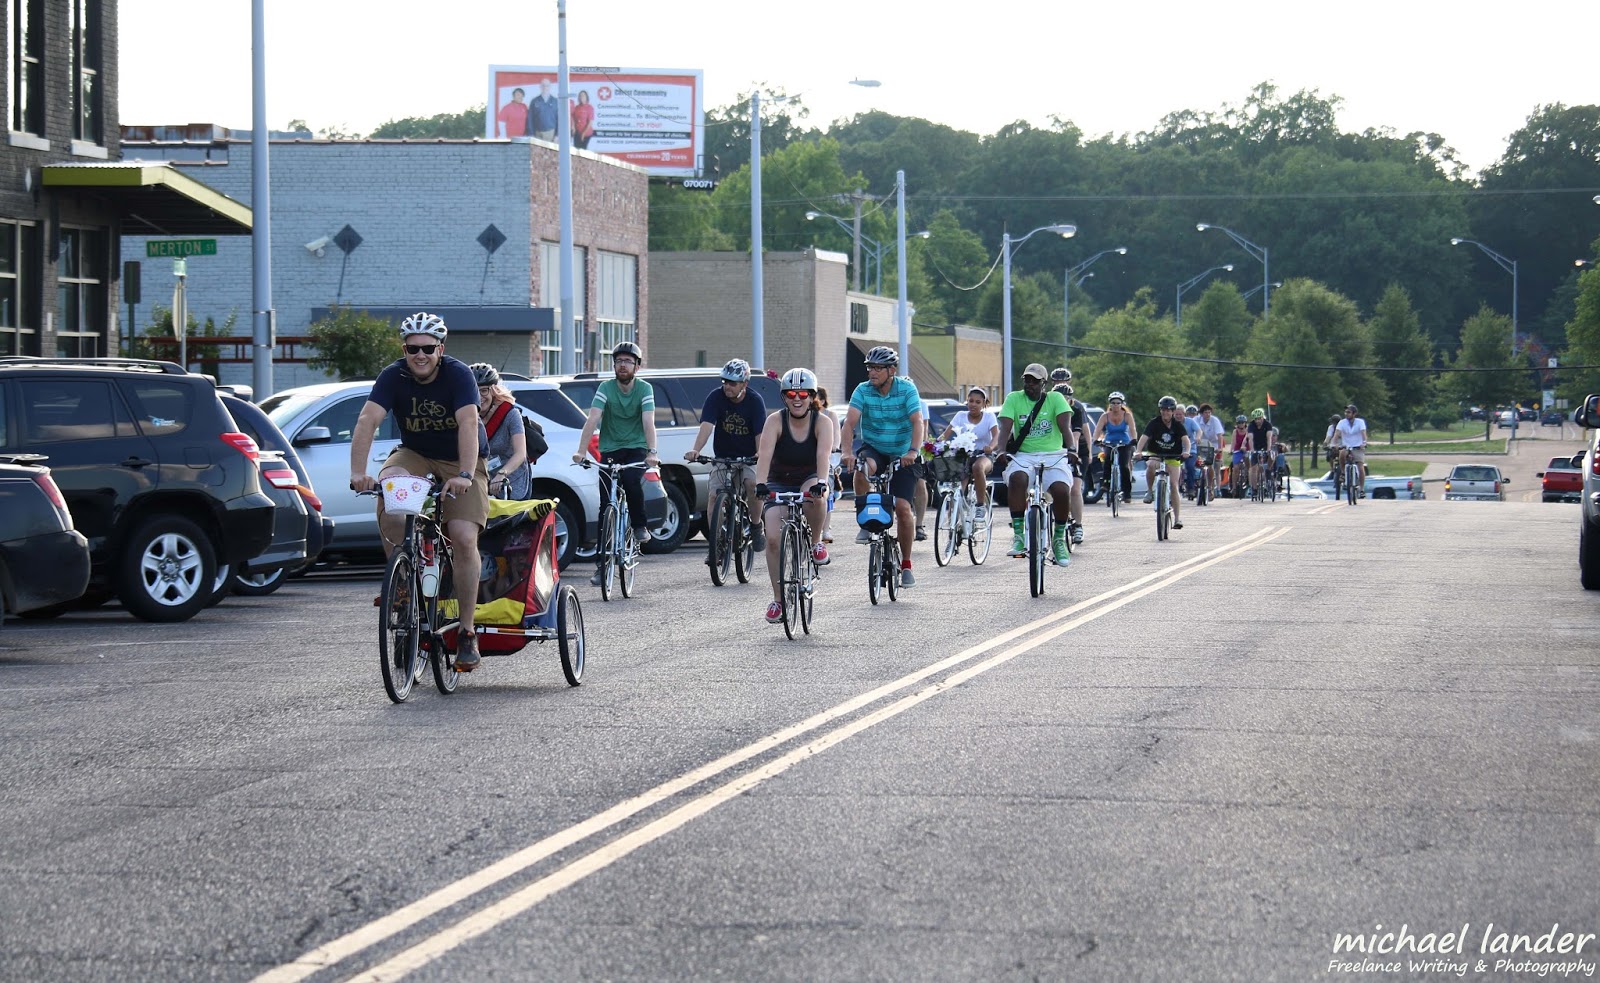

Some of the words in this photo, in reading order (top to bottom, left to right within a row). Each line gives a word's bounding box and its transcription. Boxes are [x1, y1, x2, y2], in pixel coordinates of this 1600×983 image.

[633, 89, 667, 97] Community
[660, 152, 671, 162] 20
[683, 180, 713, 188] 070071
[149, 242, 202, 256] MERTON
